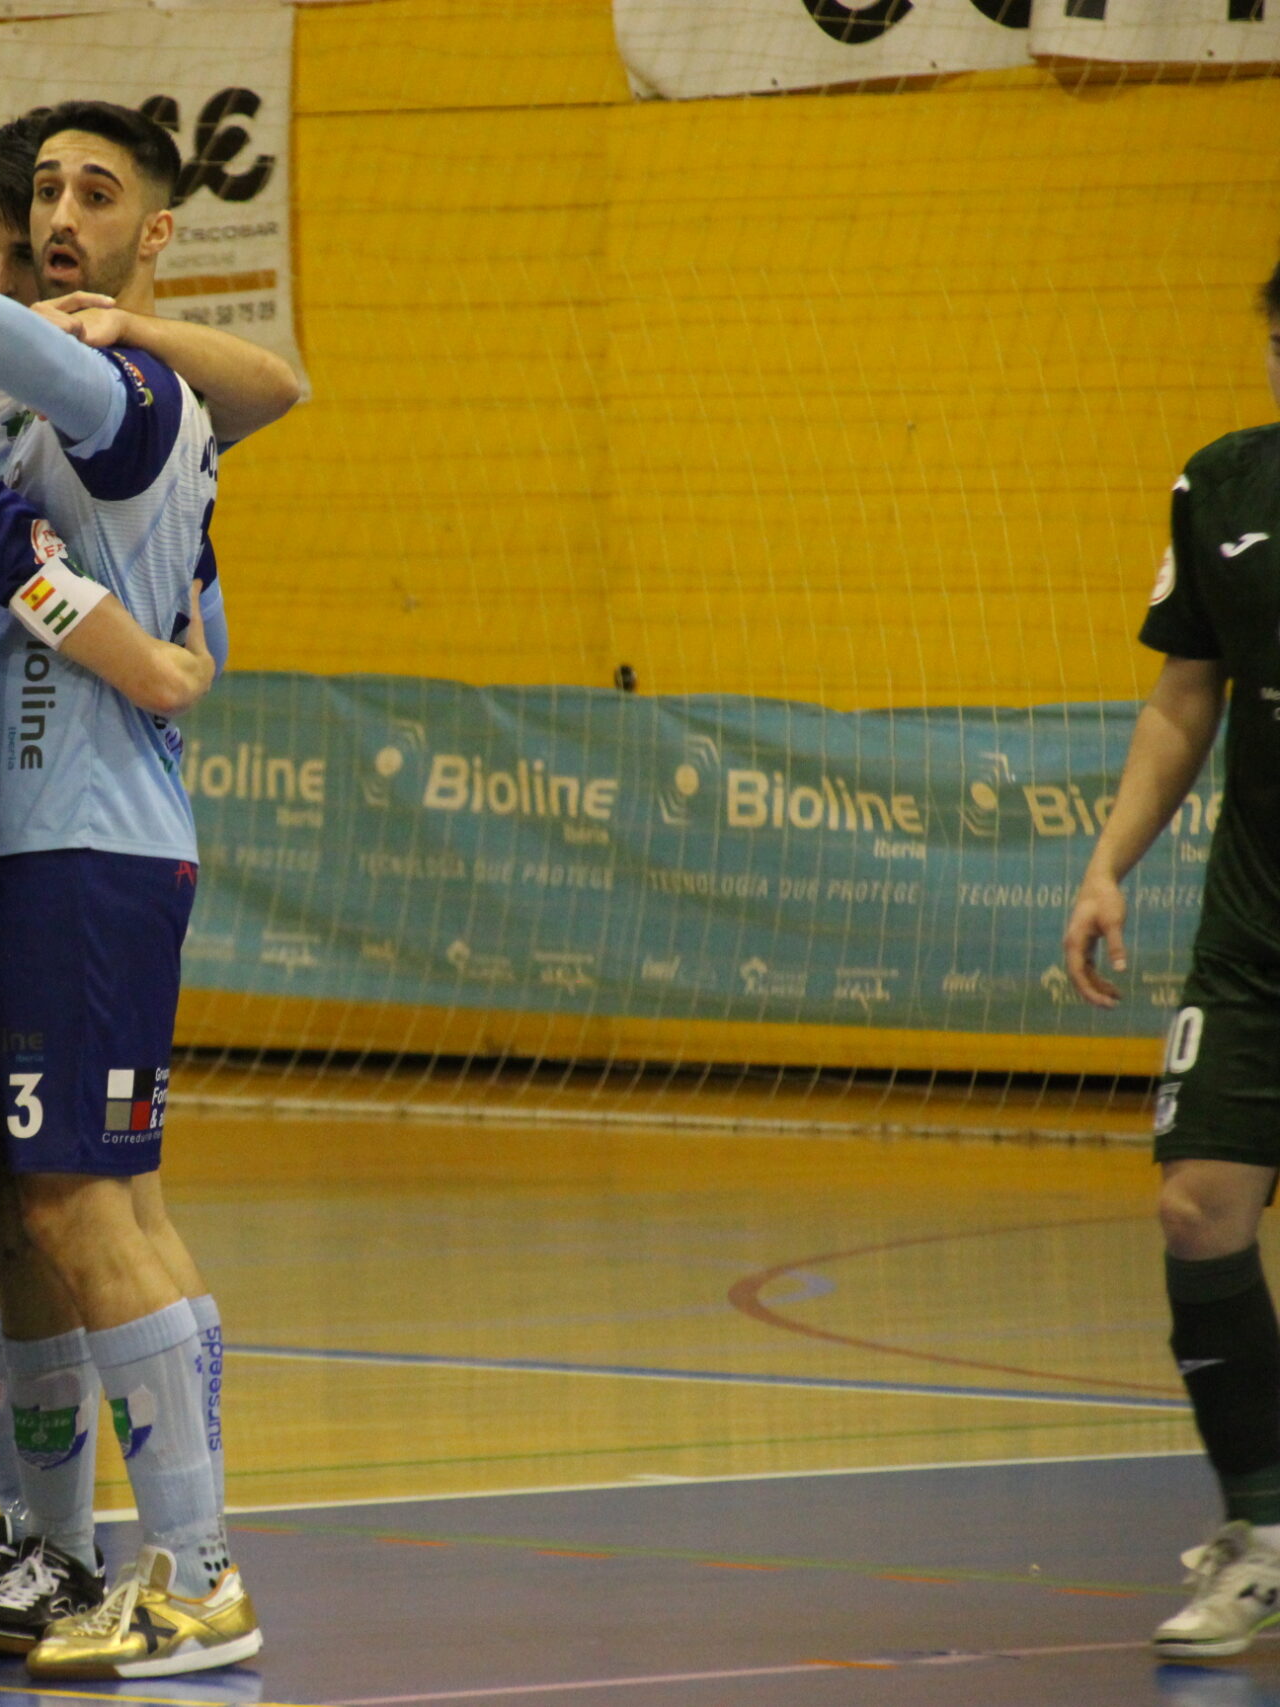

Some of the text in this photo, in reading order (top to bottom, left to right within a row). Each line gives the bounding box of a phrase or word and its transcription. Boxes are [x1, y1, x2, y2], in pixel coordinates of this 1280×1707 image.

[20, 640, 56, 769] ioline
[183, 741, 326, 802] ioline
[423, 754, 618, 820] Bioline
[727, 769, 924, 833] Bioline
[7, 1073, 43, 1139] 3
[201, 1325, 223, 1452] surseeds
